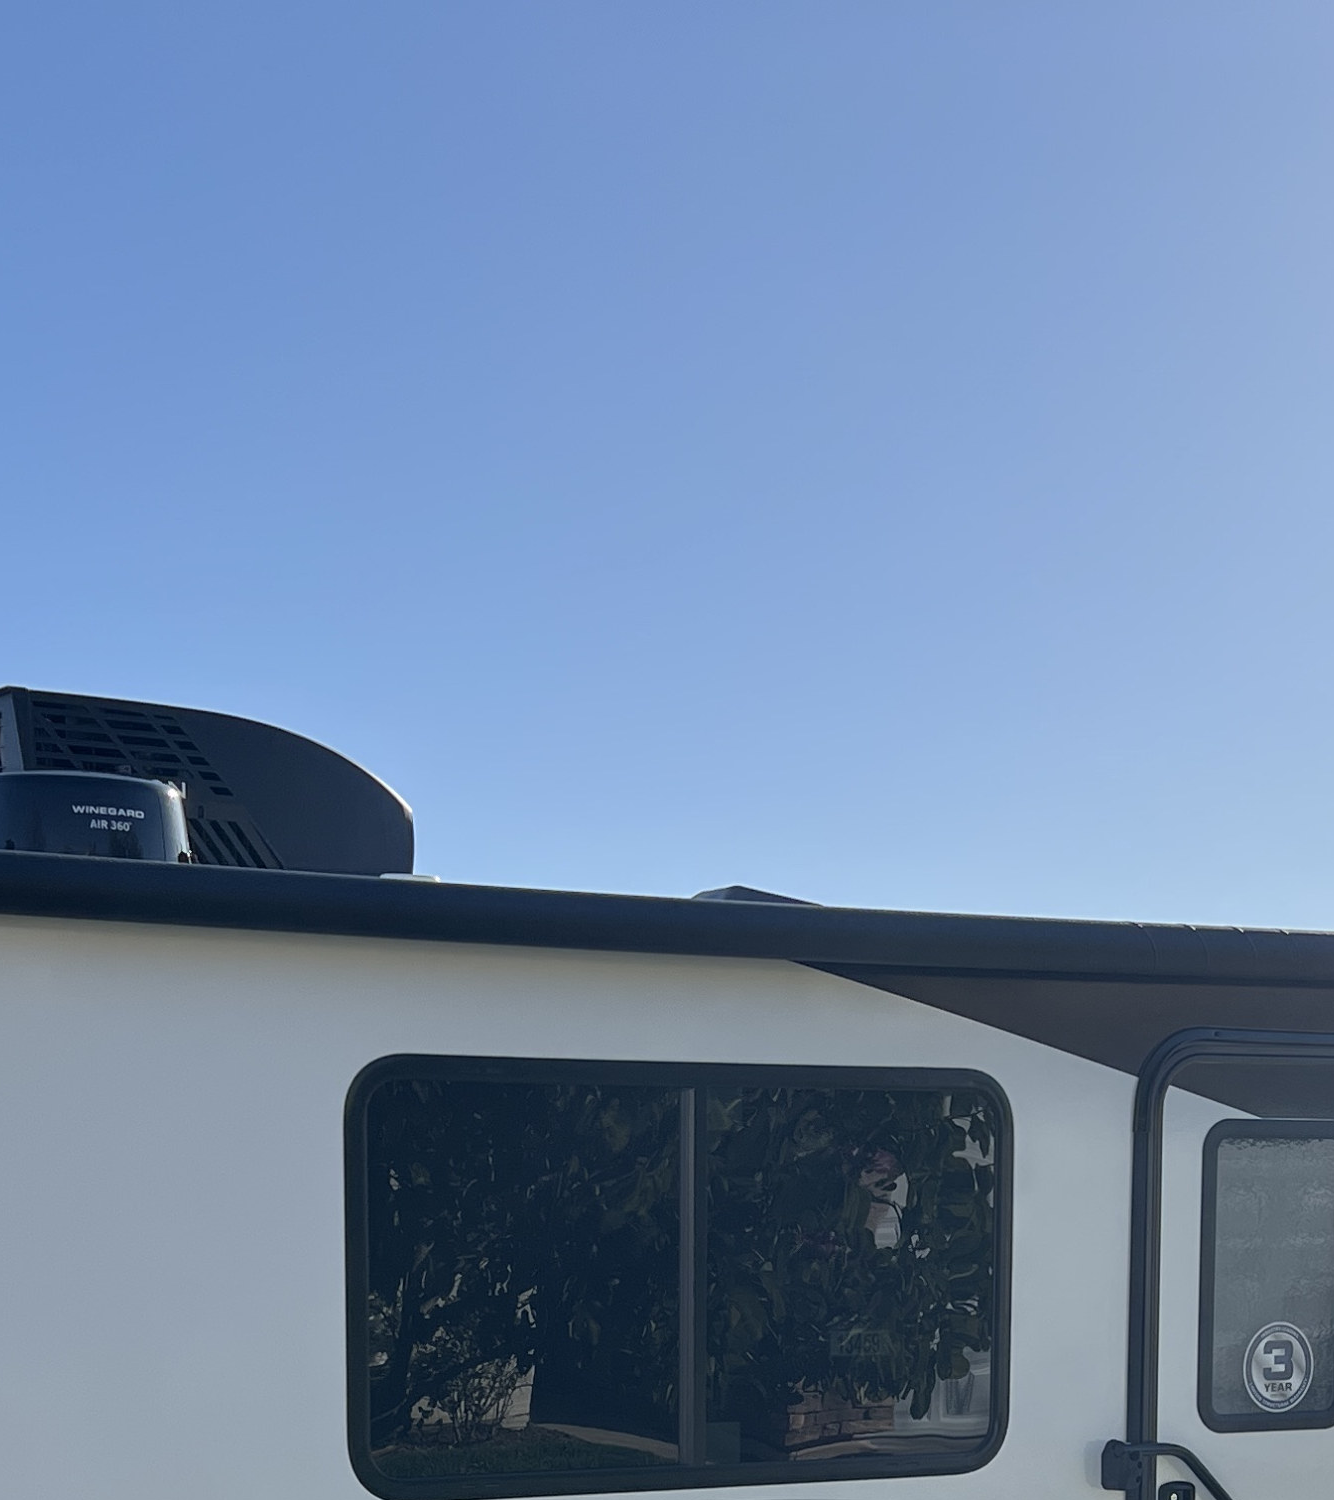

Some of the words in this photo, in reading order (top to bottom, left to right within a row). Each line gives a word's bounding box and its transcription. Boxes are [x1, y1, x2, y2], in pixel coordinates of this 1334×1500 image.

[72, 804, 145, 819] WINEGARD
[90, 818, 109, 830] AIR
[1263, 1340, 1294, 1381] 3
[1264, 1382, 1293, 1392] YEAR
